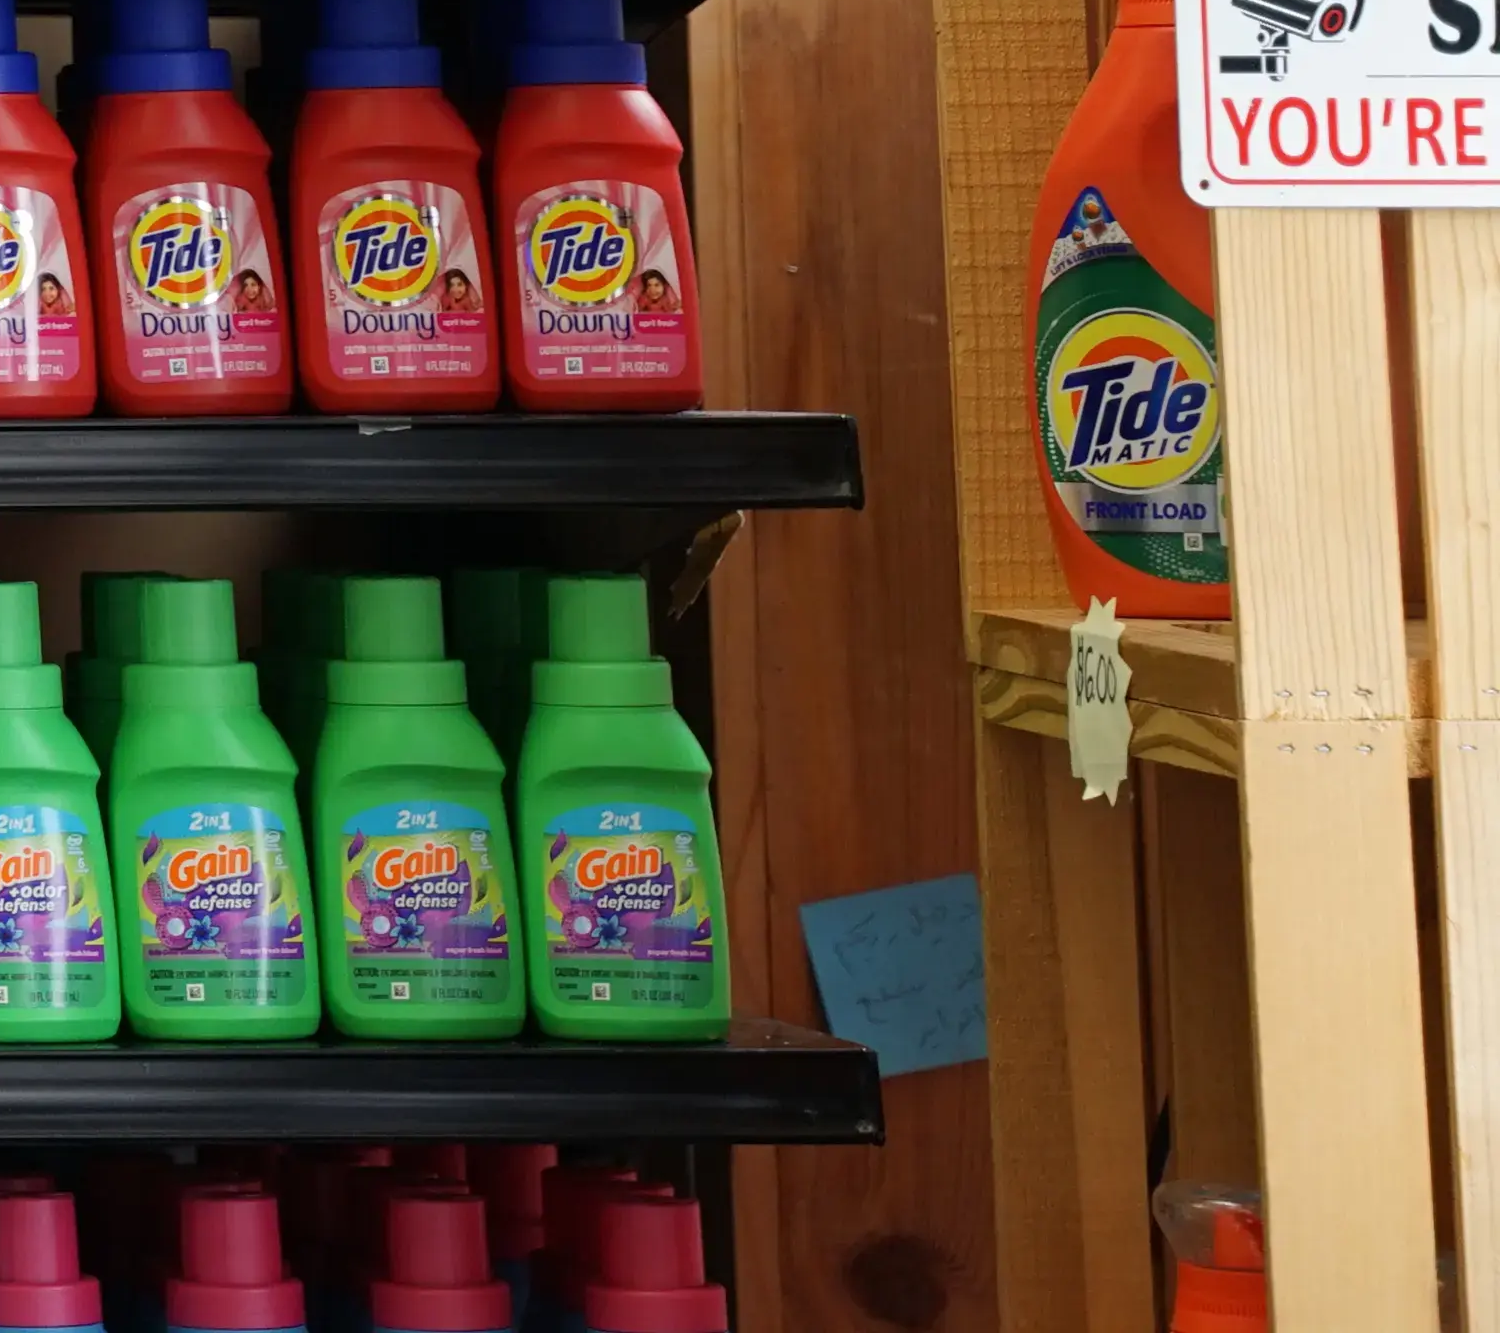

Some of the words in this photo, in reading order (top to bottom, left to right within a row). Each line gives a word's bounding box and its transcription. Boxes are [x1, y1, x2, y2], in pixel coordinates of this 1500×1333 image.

[1221, 96, 1487, 167] YOU'RE
[343, 226, 427, 288] Tide
[343, 306, 438, 342] Downy
[1061, 357, 1209, 469] Tide
[1088, 434, 1192, 468] MATIC
[1085, 501, 1144, 520] FRONT
[1151, 501, 1207, 520] LOAD
[577, 844, 661, 891] Gain
[596, 895, 662, 912] defense
